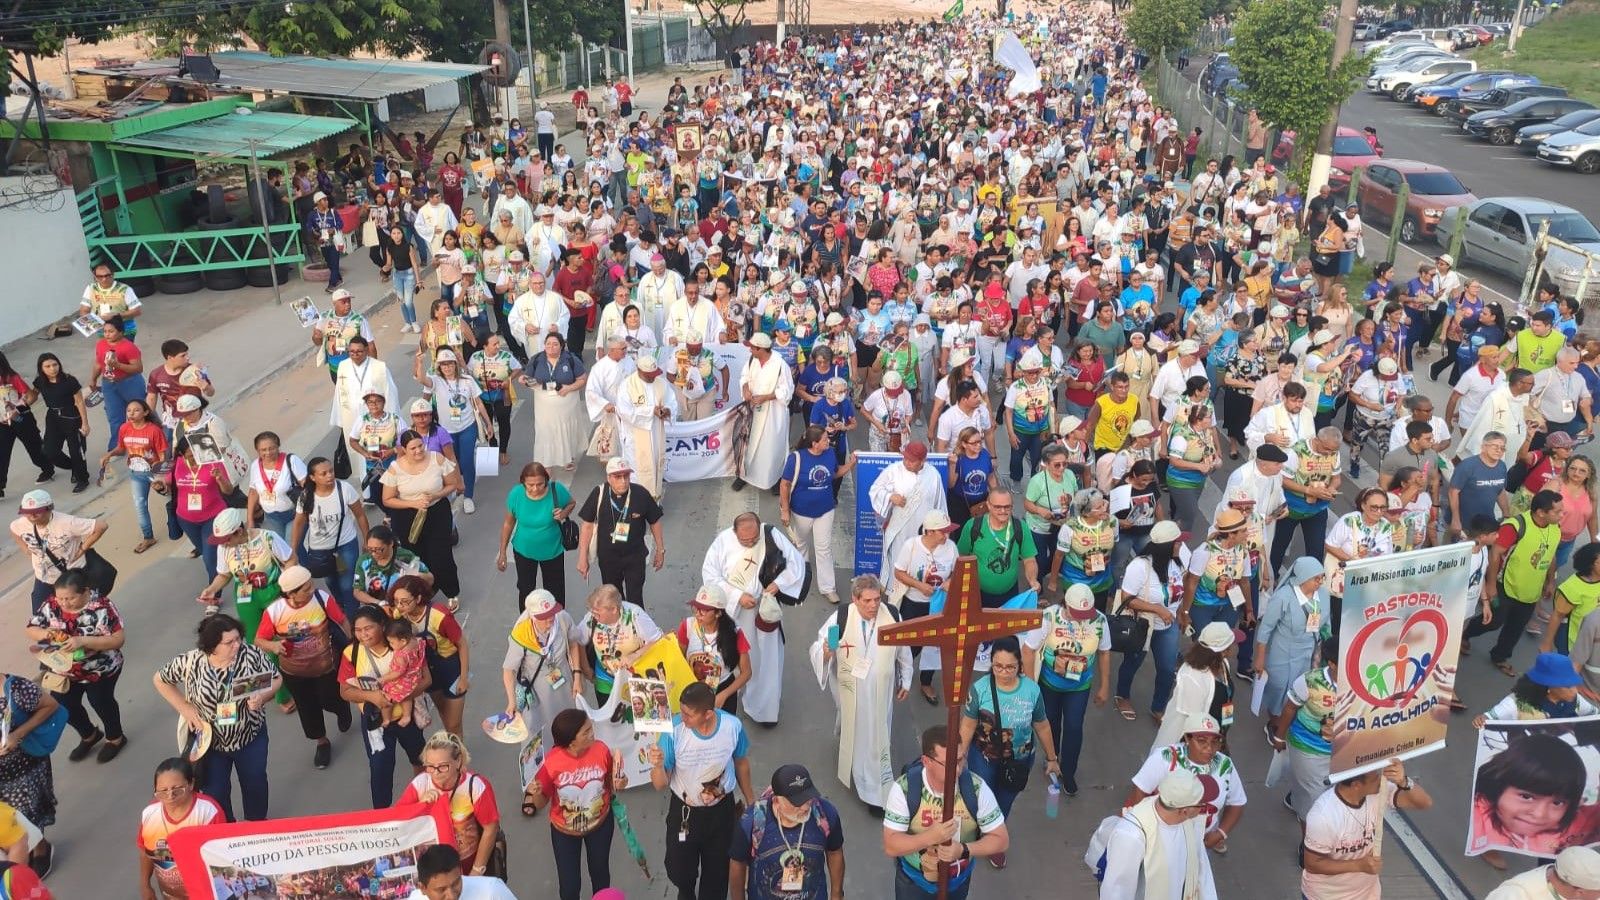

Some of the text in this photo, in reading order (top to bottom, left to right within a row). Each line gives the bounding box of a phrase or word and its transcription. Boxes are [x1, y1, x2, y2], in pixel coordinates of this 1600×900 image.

[1437, 558, 1458, 570] Paulo
[1364, 592, 1443, 620] PASTORAL
[1346, 695, 1438, 731] DA ACOLHIDA
[1355, 736, 1425, 764] Comunidade Cristo Rei
[921, 809, 934, 827] 5
[232, 837, 401, 870] GRUPO DA PESSOA IDOSA
